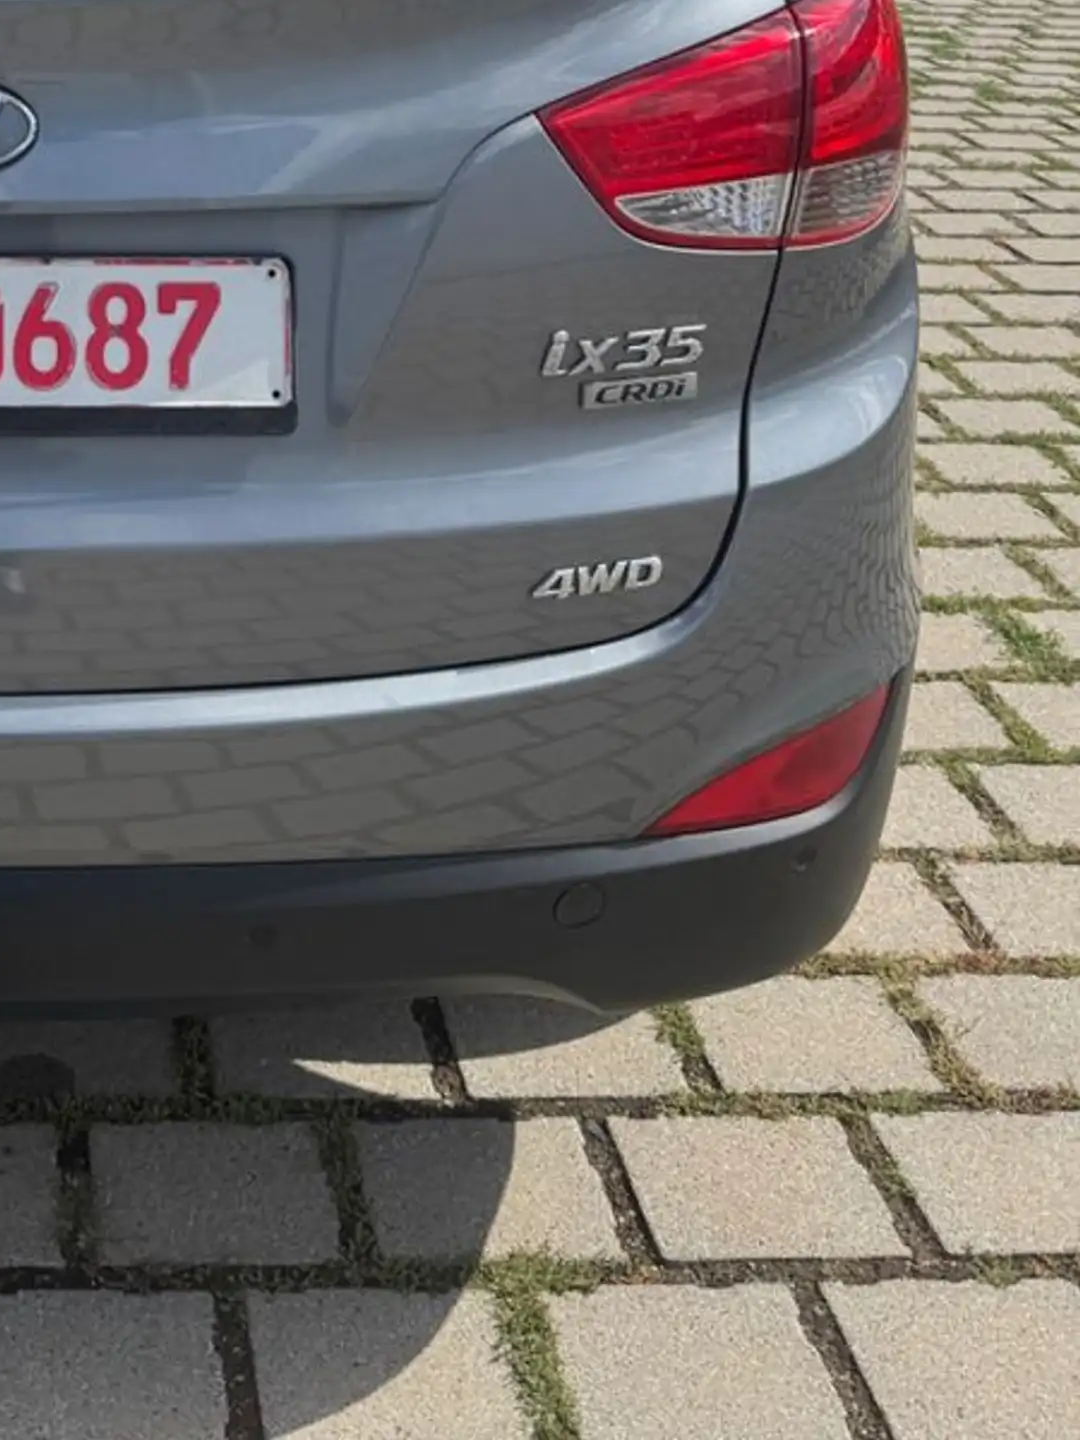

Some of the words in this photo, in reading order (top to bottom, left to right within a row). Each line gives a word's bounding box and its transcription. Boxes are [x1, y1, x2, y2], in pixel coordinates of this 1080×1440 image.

[541, 323, 708, 377] ix35
[594, 378, 687, 406] CRDi
[531, 555, 664, 600] 4WD
